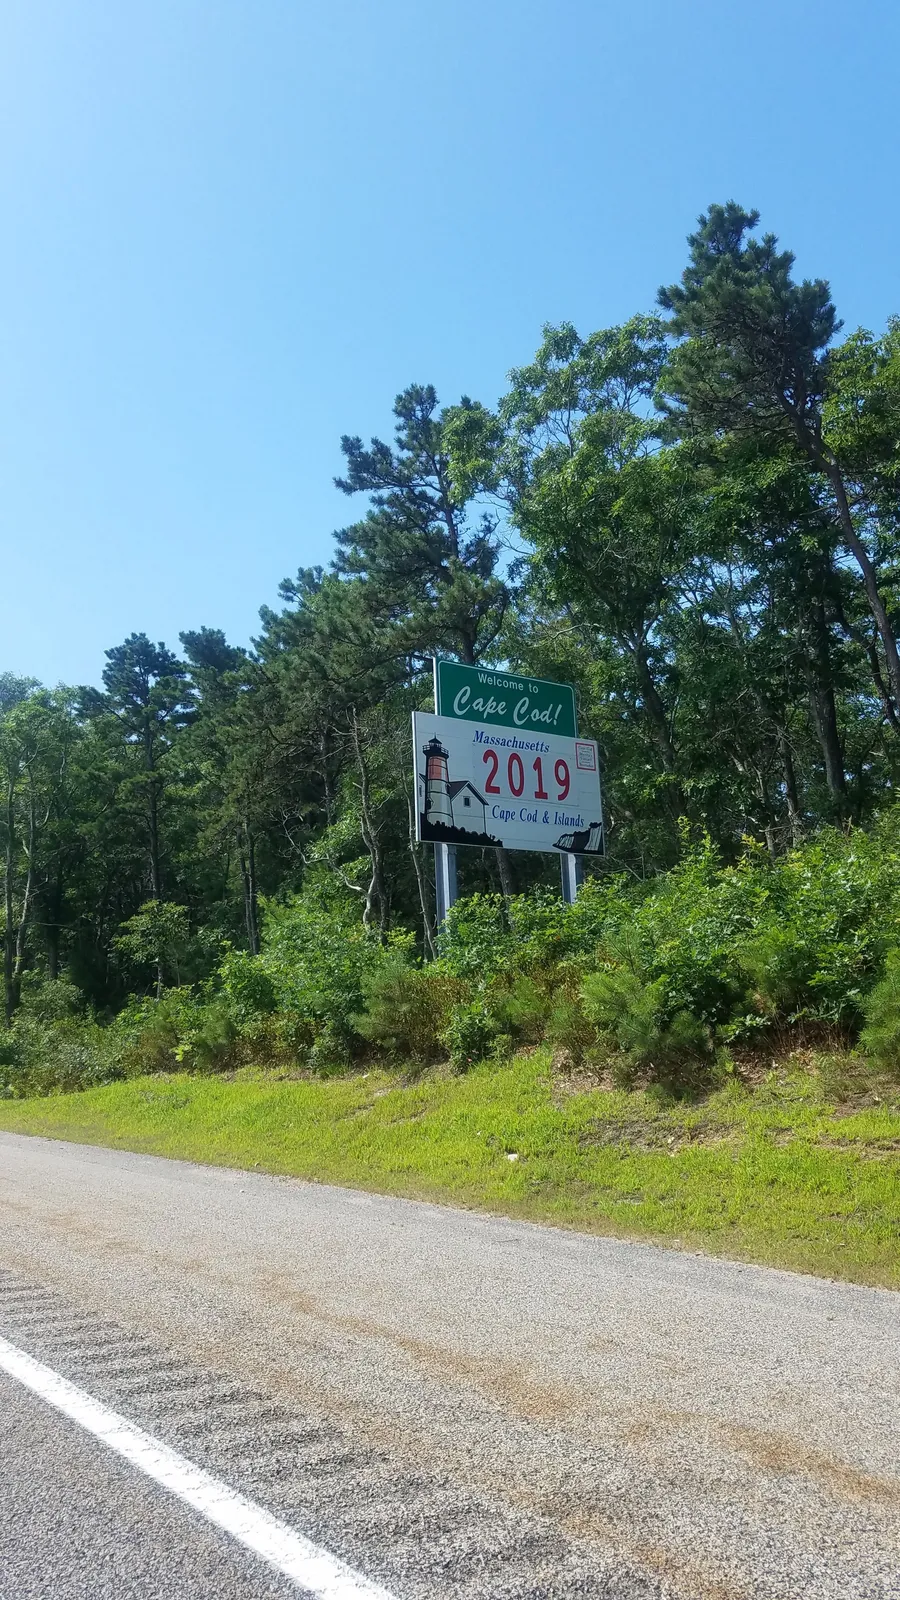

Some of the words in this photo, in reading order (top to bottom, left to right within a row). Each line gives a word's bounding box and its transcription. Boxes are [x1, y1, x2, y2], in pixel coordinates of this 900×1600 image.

[478, 673, 524, 691] Welcome
[528, 683, 539, 694] to
[453, 685, 507, 719] Cape
[513, 697, 562, 726] Cod!
[472, 730, 550, 753] Massachusetts
[483, 749, 570, 801] 2019
[492, 805, 516, 822] Cape
[519, 807, 538, 823] Cod
[542, 810, 550, 824] &
[554, 811, 585, 828] Islands
